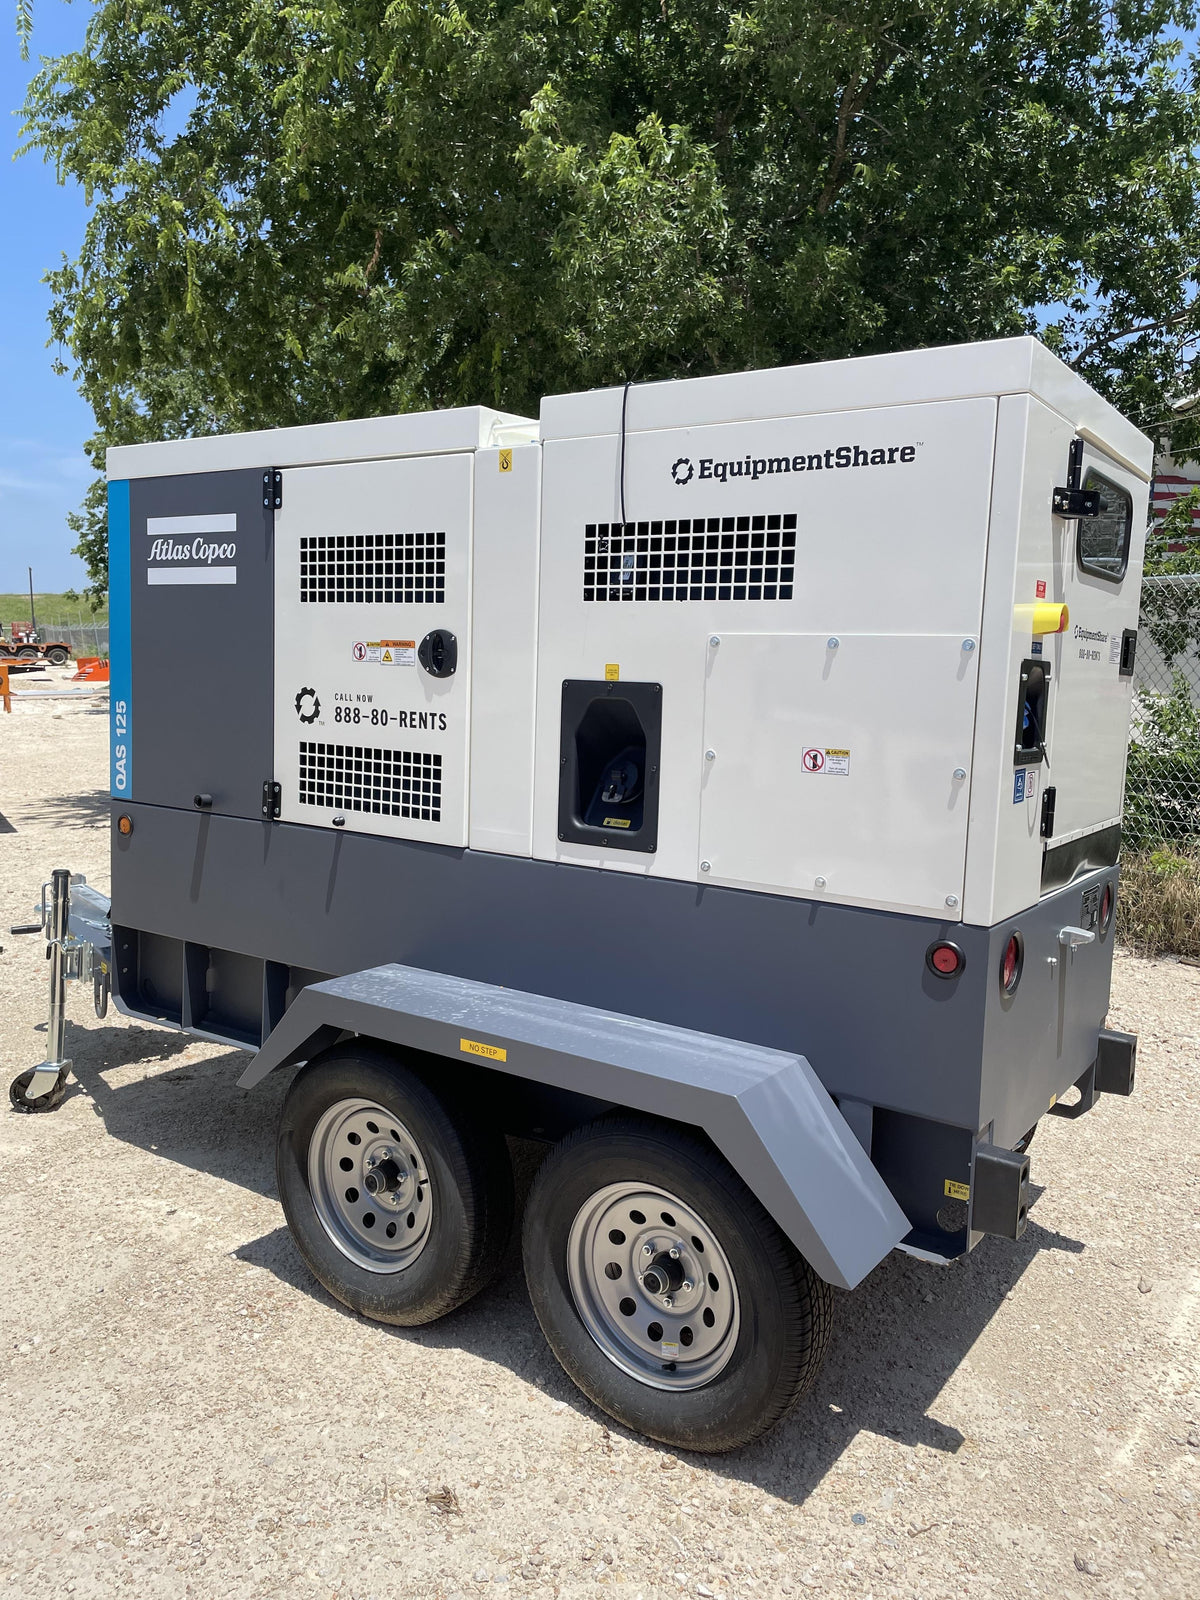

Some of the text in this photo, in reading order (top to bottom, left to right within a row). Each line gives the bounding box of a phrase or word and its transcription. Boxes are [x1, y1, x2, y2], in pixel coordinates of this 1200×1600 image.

[698, 445, 916, 483] EquipmentShare
[147, 537, 237, 564] Atlas Copco
[334, 692, 374, 703] CALL NOW
[334, 706, 448, 731] 888-80-RENTS
[115, 700, 127, 791] QAS 125
[469, 1043, 498, 1056] NO STEP
